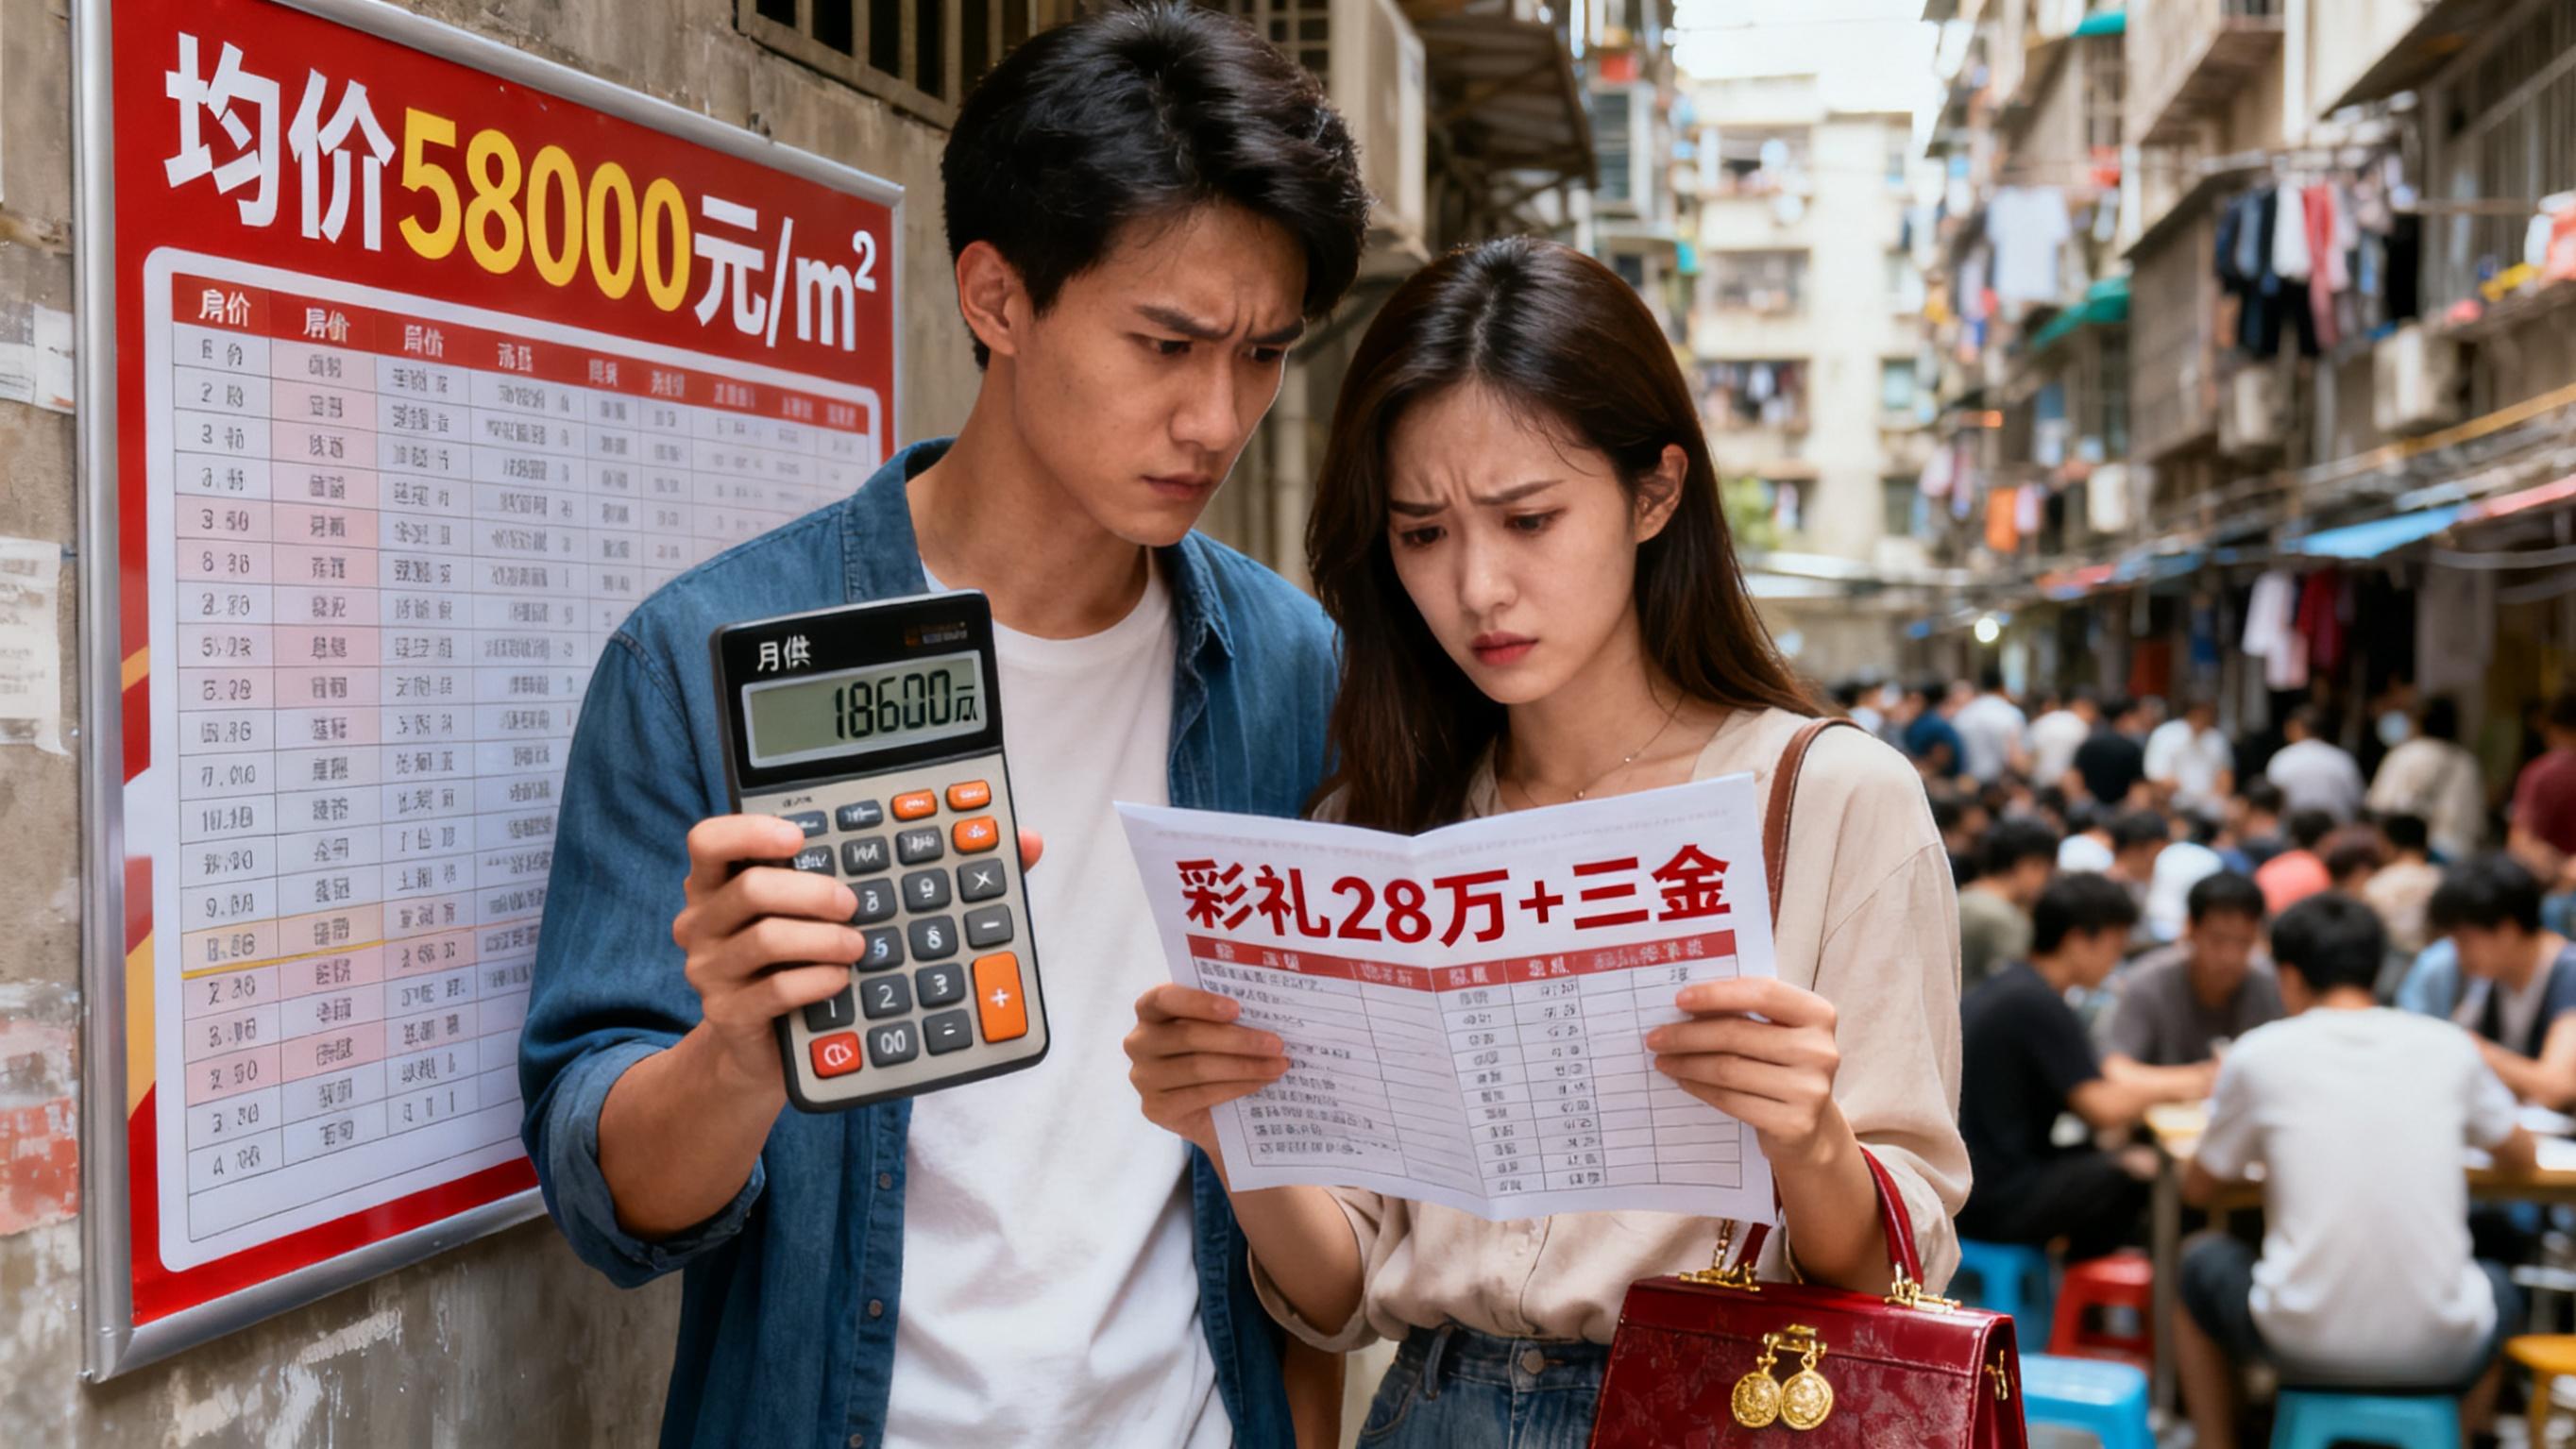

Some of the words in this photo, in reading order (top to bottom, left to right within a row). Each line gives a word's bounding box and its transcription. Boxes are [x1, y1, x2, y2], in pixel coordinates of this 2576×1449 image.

[757, 635, 811, 672] 月供
[1177, 844, 1731, 948] 彩礼28万+三金
[878, 984, 897, 1009] 2
